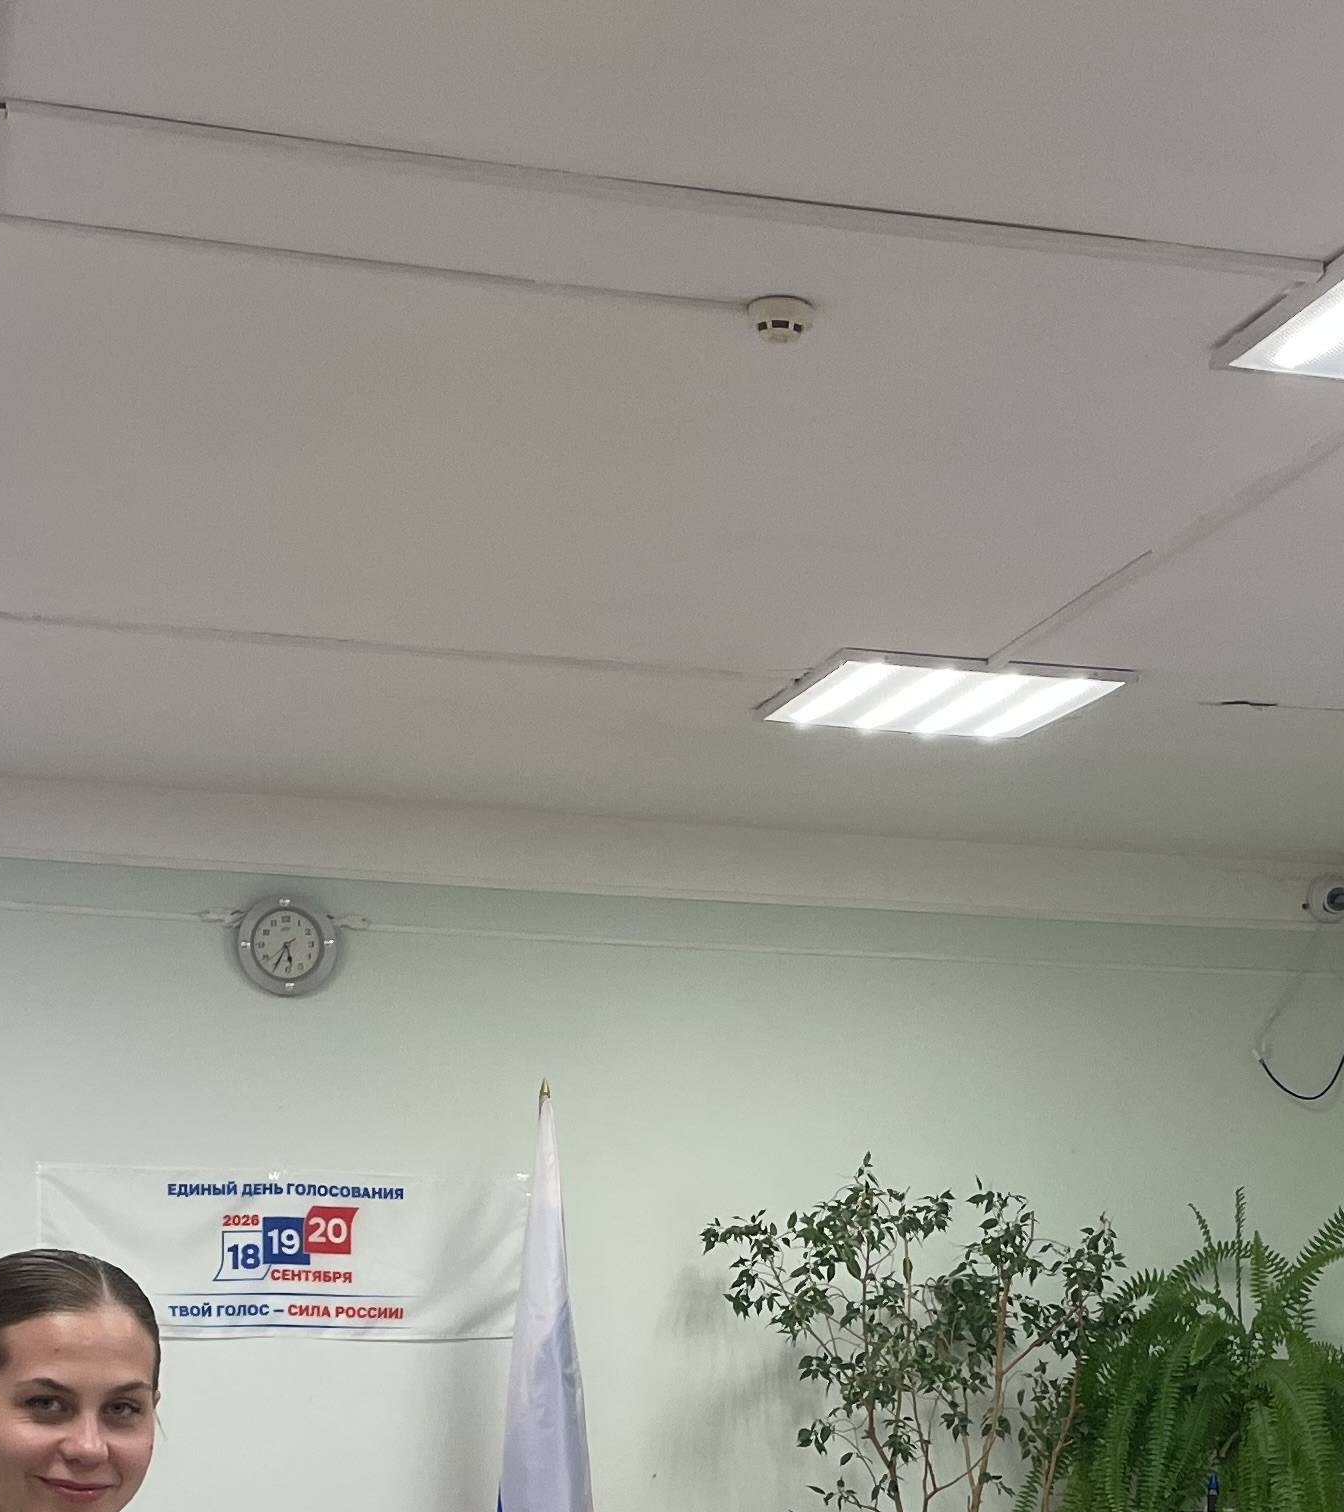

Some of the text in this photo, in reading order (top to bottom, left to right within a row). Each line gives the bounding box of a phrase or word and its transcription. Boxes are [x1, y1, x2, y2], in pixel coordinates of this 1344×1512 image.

[167, 1181, 404, 1199] ЕДИНЫЙ ДЕНЬ ГОЛОСОВАНИЯ
[222, 1214, 260, 1226] 2026
[227, 1217, 348, 1270] 18 19 20
[271, 1269, 353, 1284] СЕНТЯБРЯ
[168, 1303, 212, 1317] ТВОЙ
[217, 1304, 270, 1318] ГОЛОС
[288, 1304, 331, 1318] СИЛА
[336, 1305, 404, 1320] РОССИИ!
